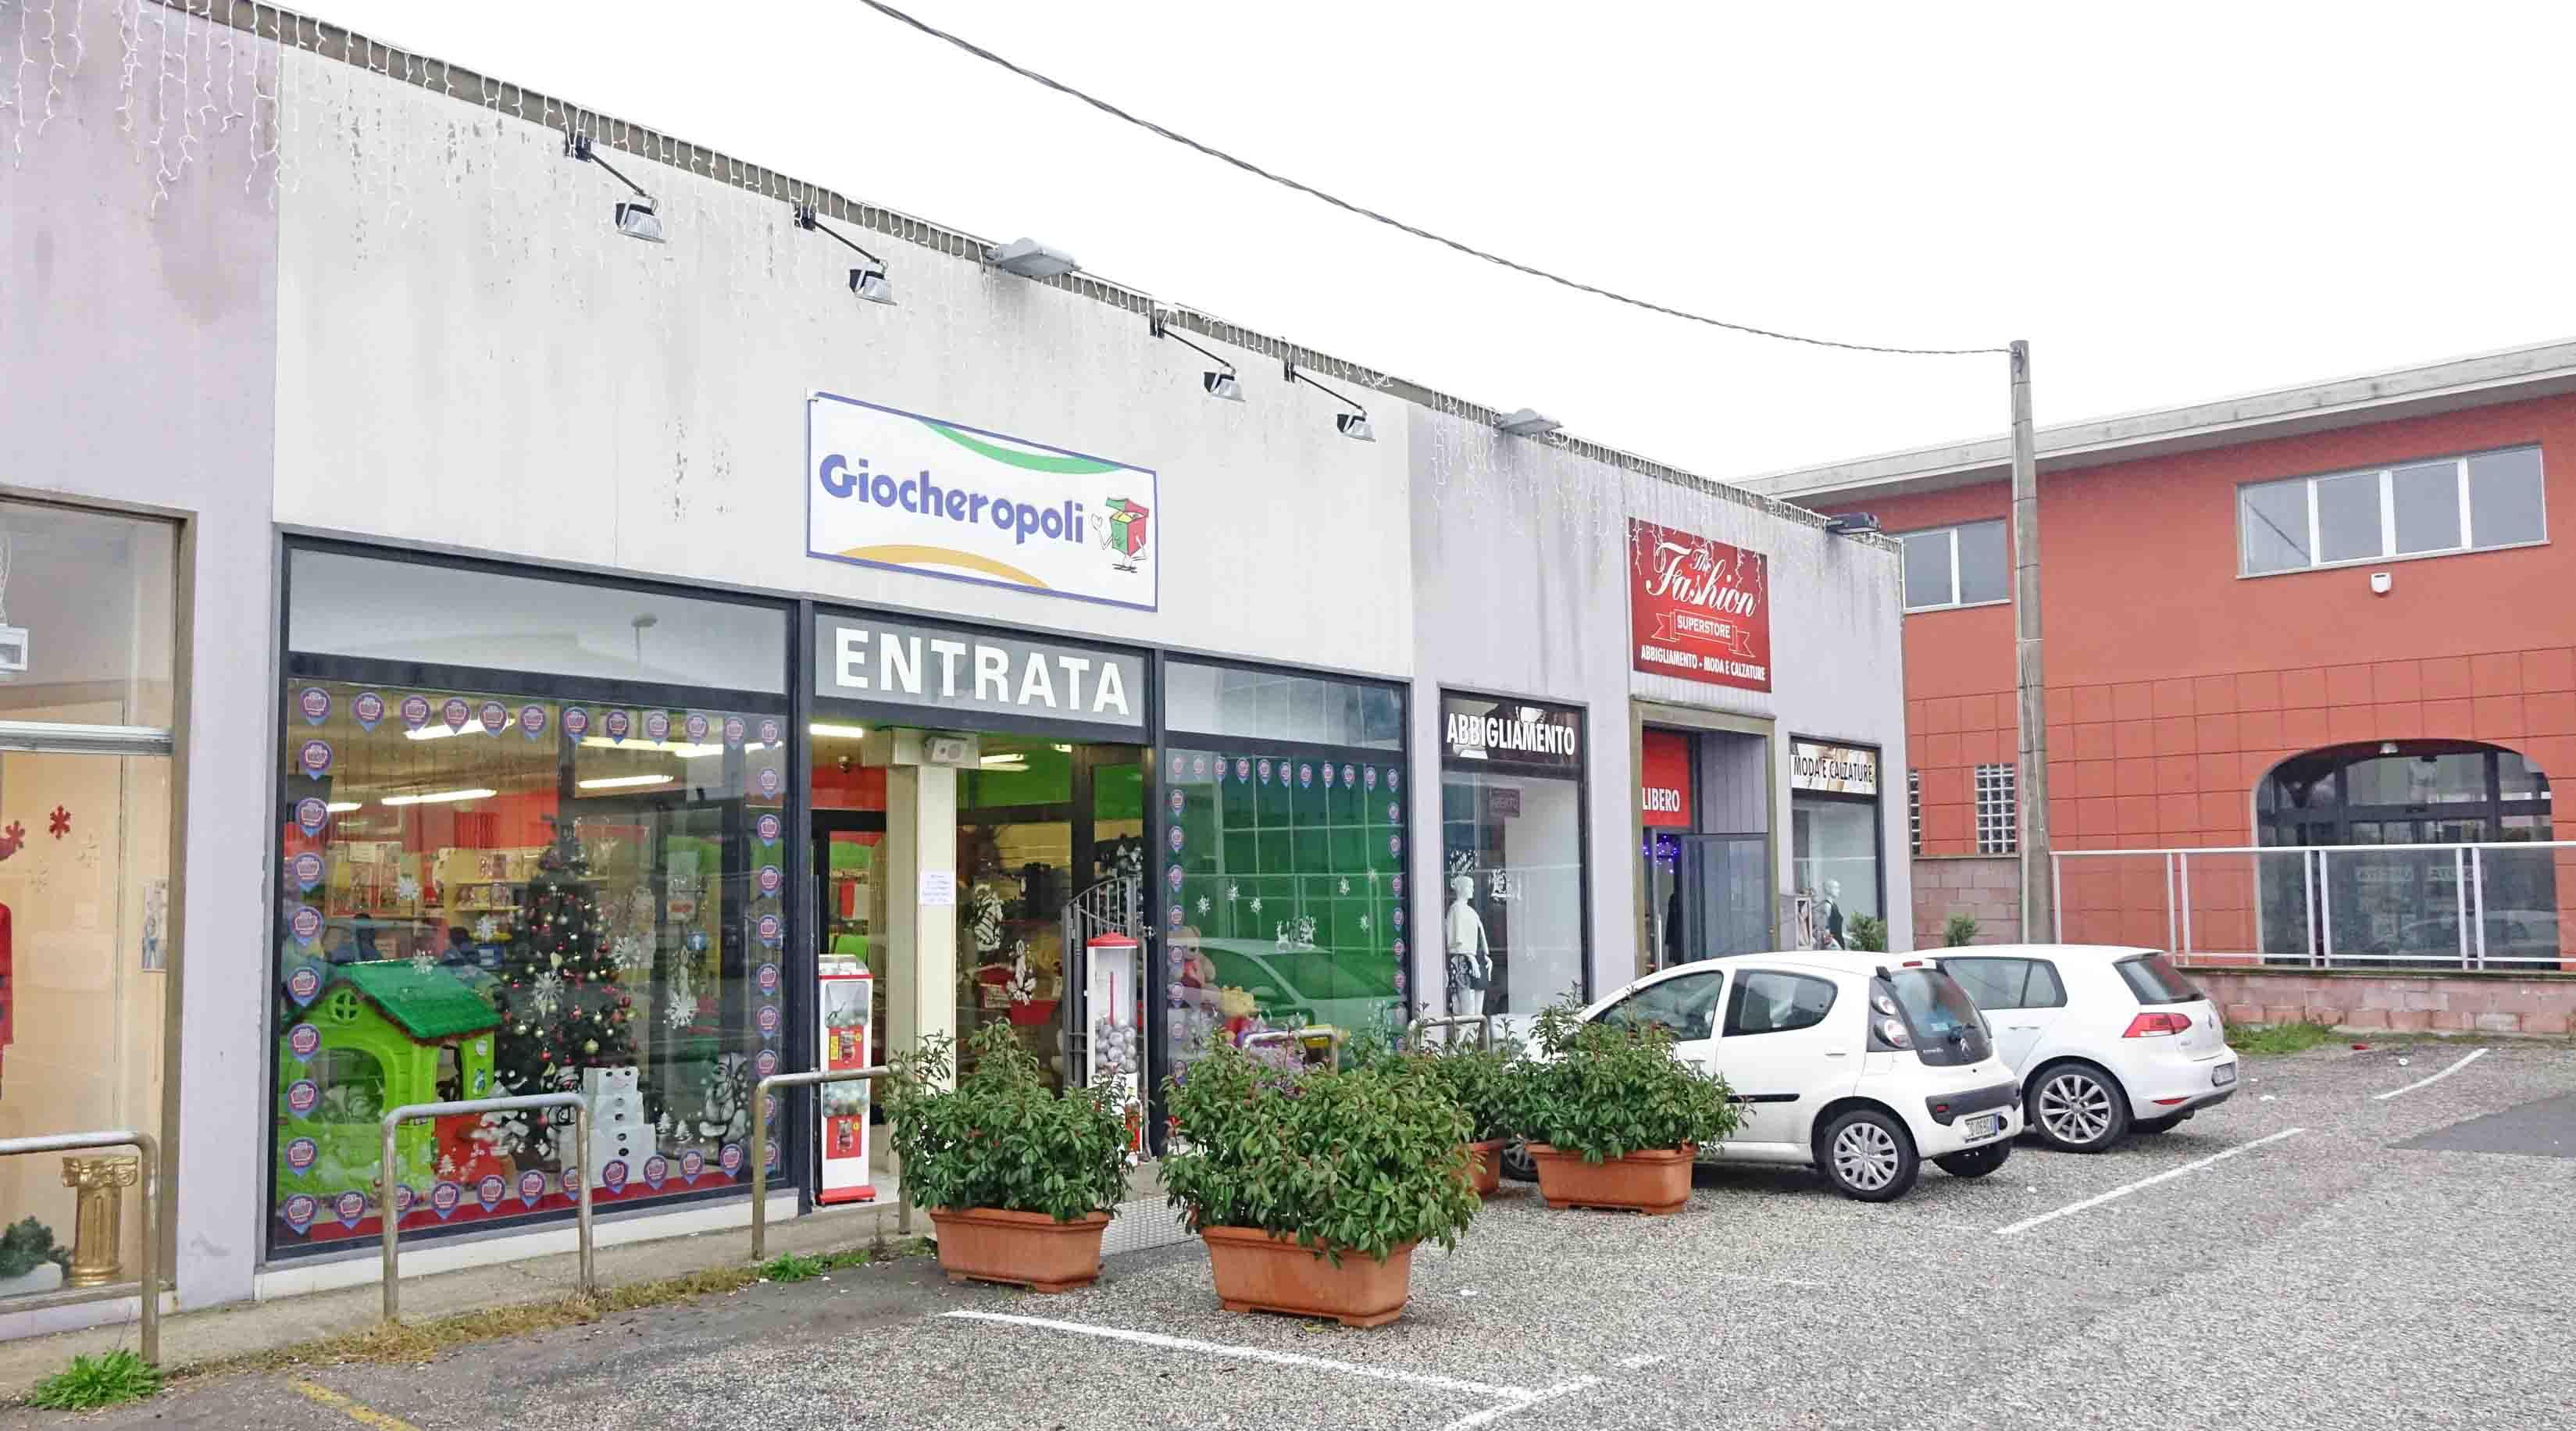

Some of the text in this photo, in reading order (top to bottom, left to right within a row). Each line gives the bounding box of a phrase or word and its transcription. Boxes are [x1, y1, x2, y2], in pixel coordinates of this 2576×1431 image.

[819, 454, 1083, 544] Giocheropoli
[1689, 548, 1711, 573] The
[1646, 542, 1756, 617] Fashion
[1676, 615, 1731, 638] SUPERSTORE
[834, 627, 1130, 716] ENTRATA
[1640, 644, 1698, 669] ABBIGLIAMENTO
[1704, 655, 1725, 675] MODA
[1725, 660, 1731, 675] E
[1731, 661, 1766, 681] CALZATURE
[1447, 712, 1575, 756] ABBIGLIAMENTO
[1793, 755, 1872, 783] MODA E CALZATURE
[1643, 787, 1680, 812] LIBERO
